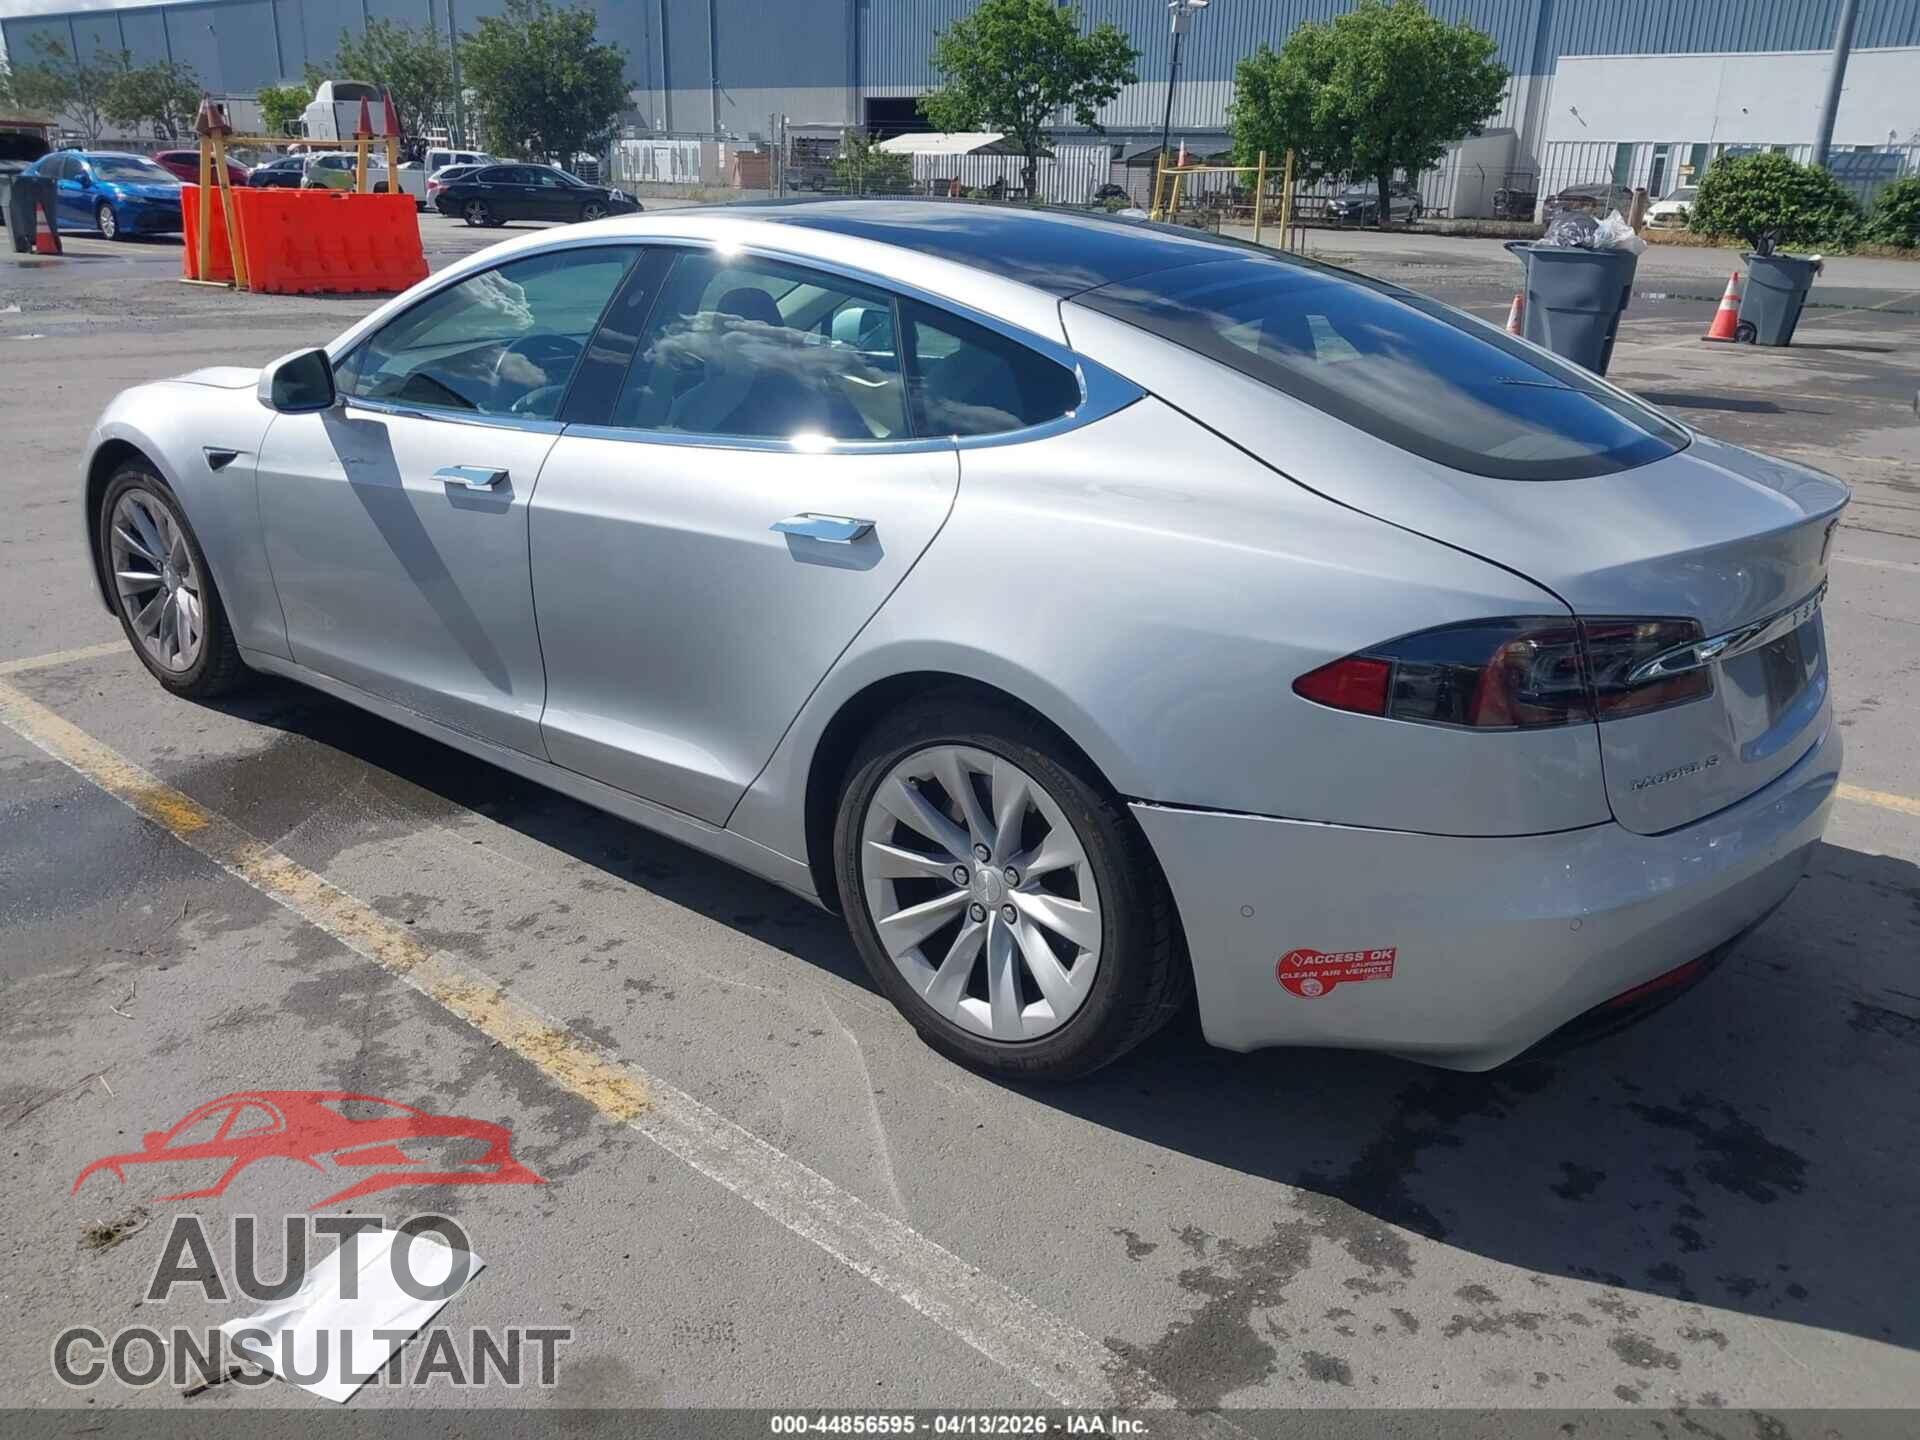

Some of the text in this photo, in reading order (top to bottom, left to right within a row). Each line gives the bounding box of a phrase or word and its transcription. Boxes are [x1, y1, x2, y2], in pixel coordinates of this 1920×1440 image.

[1304, 950, 1393, 965] ACCESS OK
[1280, 971, 1318, 979] CLEAN
[1345, 965, 1392, 975] VEHICLE
